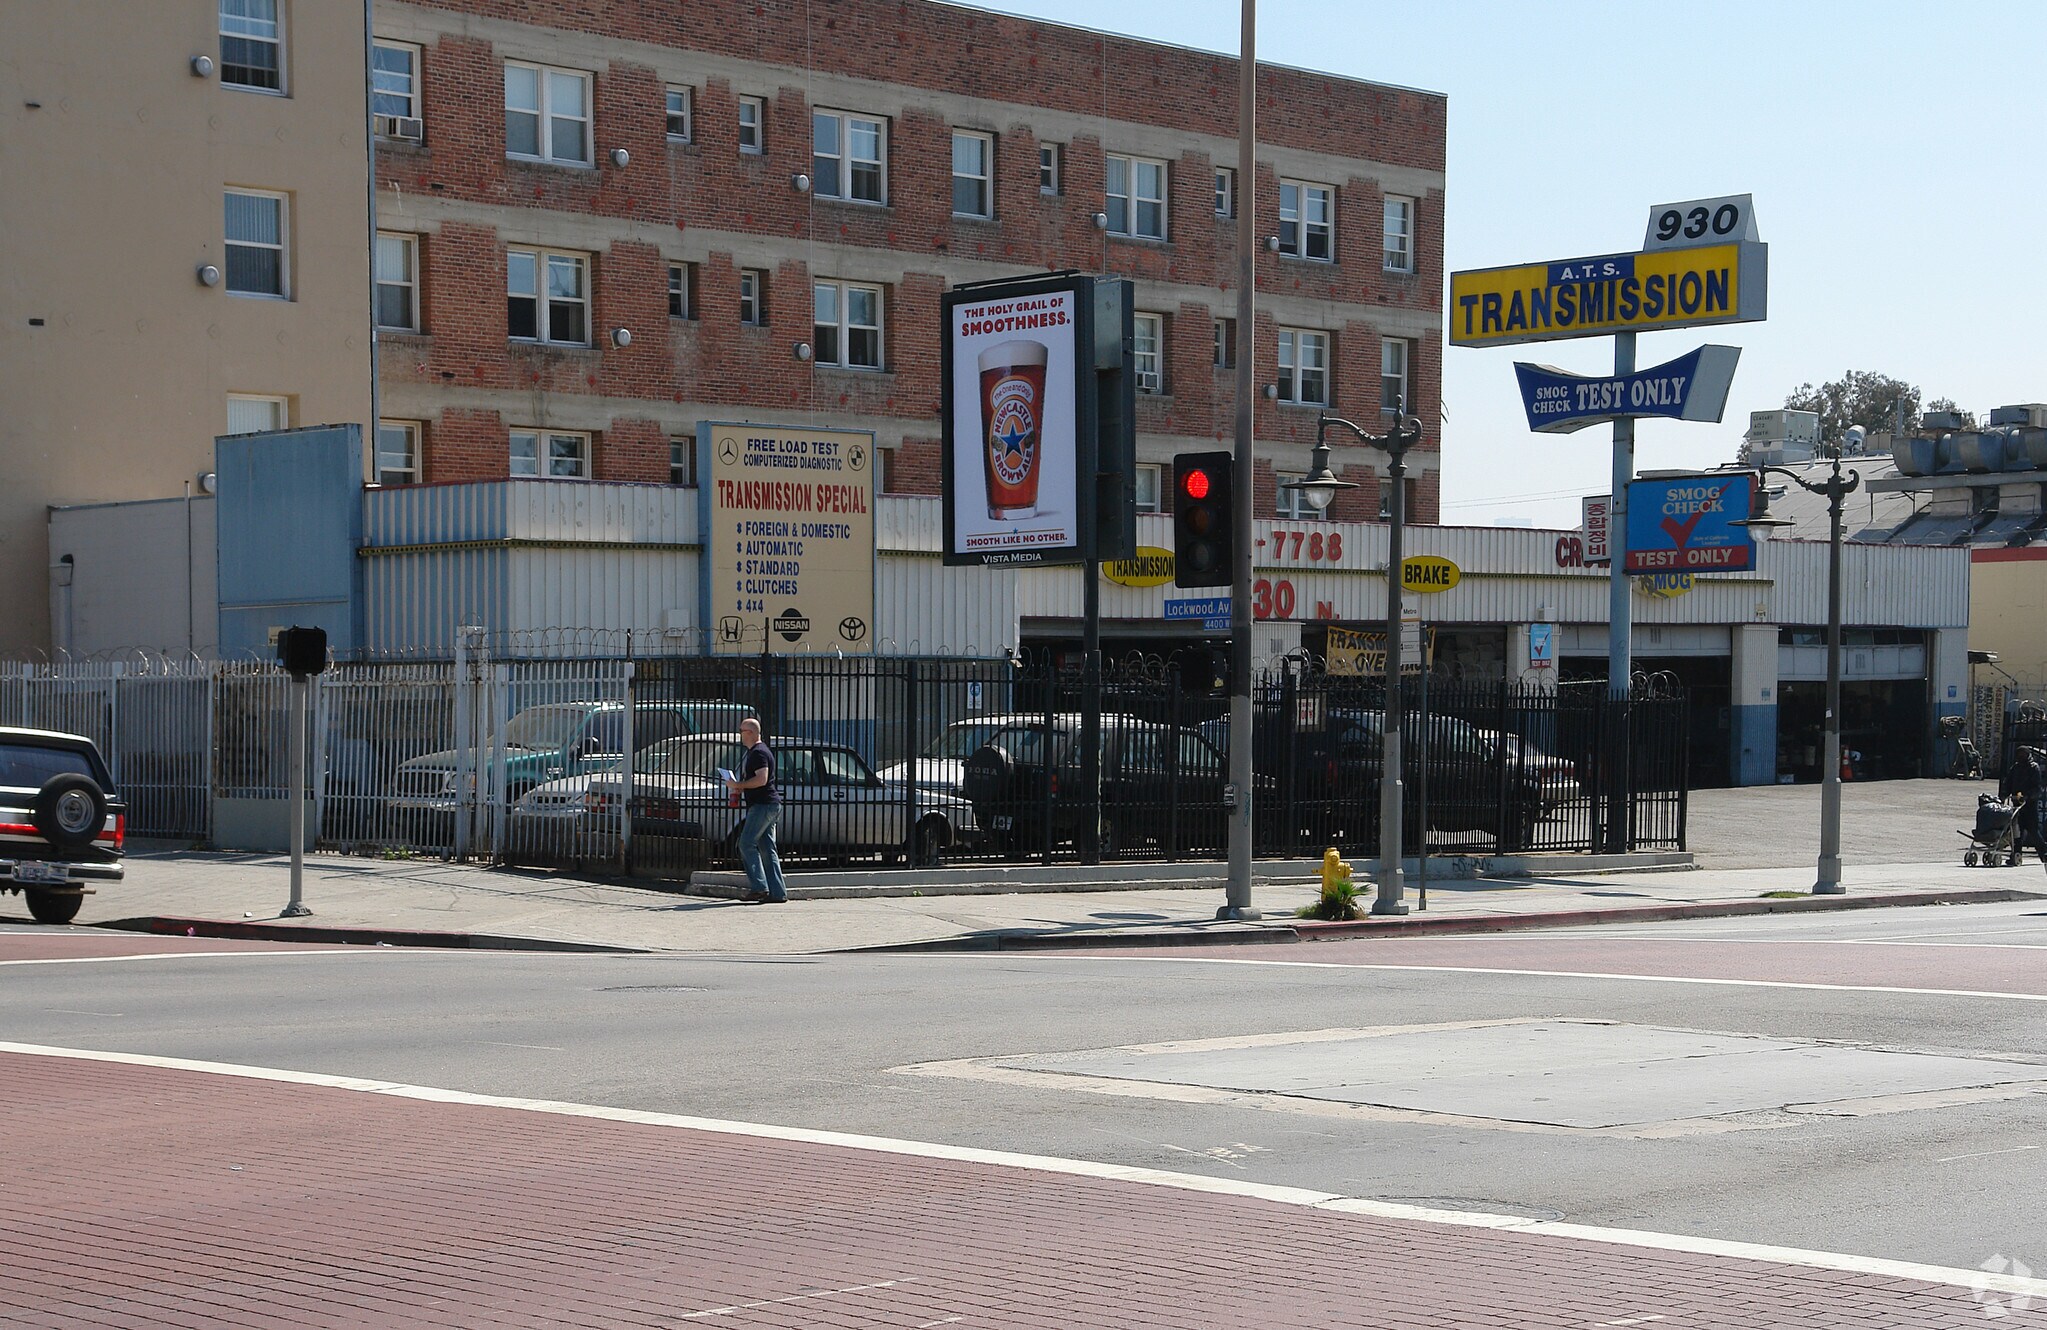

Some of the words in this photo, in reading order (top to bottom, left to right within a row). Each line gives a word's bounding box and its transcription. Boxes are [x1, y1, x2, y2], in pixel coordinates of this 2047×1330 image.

[1656, 204, 1739, 241] 930
[964, 308, 984, 319] THE
[988, 304, 1014, 317] HOLY
[1016, 300, 1047, 314] GRAIL
[1050, 297, 1064, 308] OF
[1460, 268, 1728, 334] TRANSMISSION
[961, 310, 1071, 337] SMOOTHNESS.
[1536, 386, 1568, 399] SMOG
[1576, 381, 1625, 410] TEST
[1630, 377, 1686, 406] ONLY
[1532, 399, 1571, 414] CHECK
[994, 402, 1032, 433] NEWCASTLE
[747, 439, 775, 452] FREE
[779, 440, 808, 454] LOAD
[812, 442, 839, 456] TEST
[743, 454, 798, 469] COMPUTERIZED
[800, 456, 842, 471] DIAGNOSTIC
[994, 453, 1024, 481] BROWN
[1022, 450, 1032, 473] ALE
[718, 480, 811, 512] TRANSMISSION
[816, 484, 867, 514] SPECIAL
[1666, 486, 1720, 501] SMOG
[1661, 500, 1724, 515] CHECK
[745, 521, 788, 537] FOREIGN
[792, 523, 798, 537] &
[801, 523, 850, 539] DOMESTIC
[966, 534, 1001, 547] SMOOTH
[1003, 534, 1021, 545] LIKE
[1023, 533, 1035, 543] NO
[1037, 532, 1068, 543] OTHER.
[745, 541, 804, 556] AUTOMATIC
[1112, 556, 1174, 577] TRANSMISSION
[1635, 551, 1678, 567] TEST
[1687, 549, 1733, 564] ONLY
[745, 560, 800, 576] STANDARD
[1404, 564, 1450, 585] BRAKE
[745, 579, 798, 595] CLUTCHES
[745, 599, 764, 613] 4x4
[1253, 579, 1295, 619] 30
[1167, 602, 1213, 616] Lockwood
[1217, 602, 1229, 614] Av
[774, 620, 809, 631] NISSAN
[1205, 620, 1224, 629] 4400
[1224, 620, 1230, 628] W
